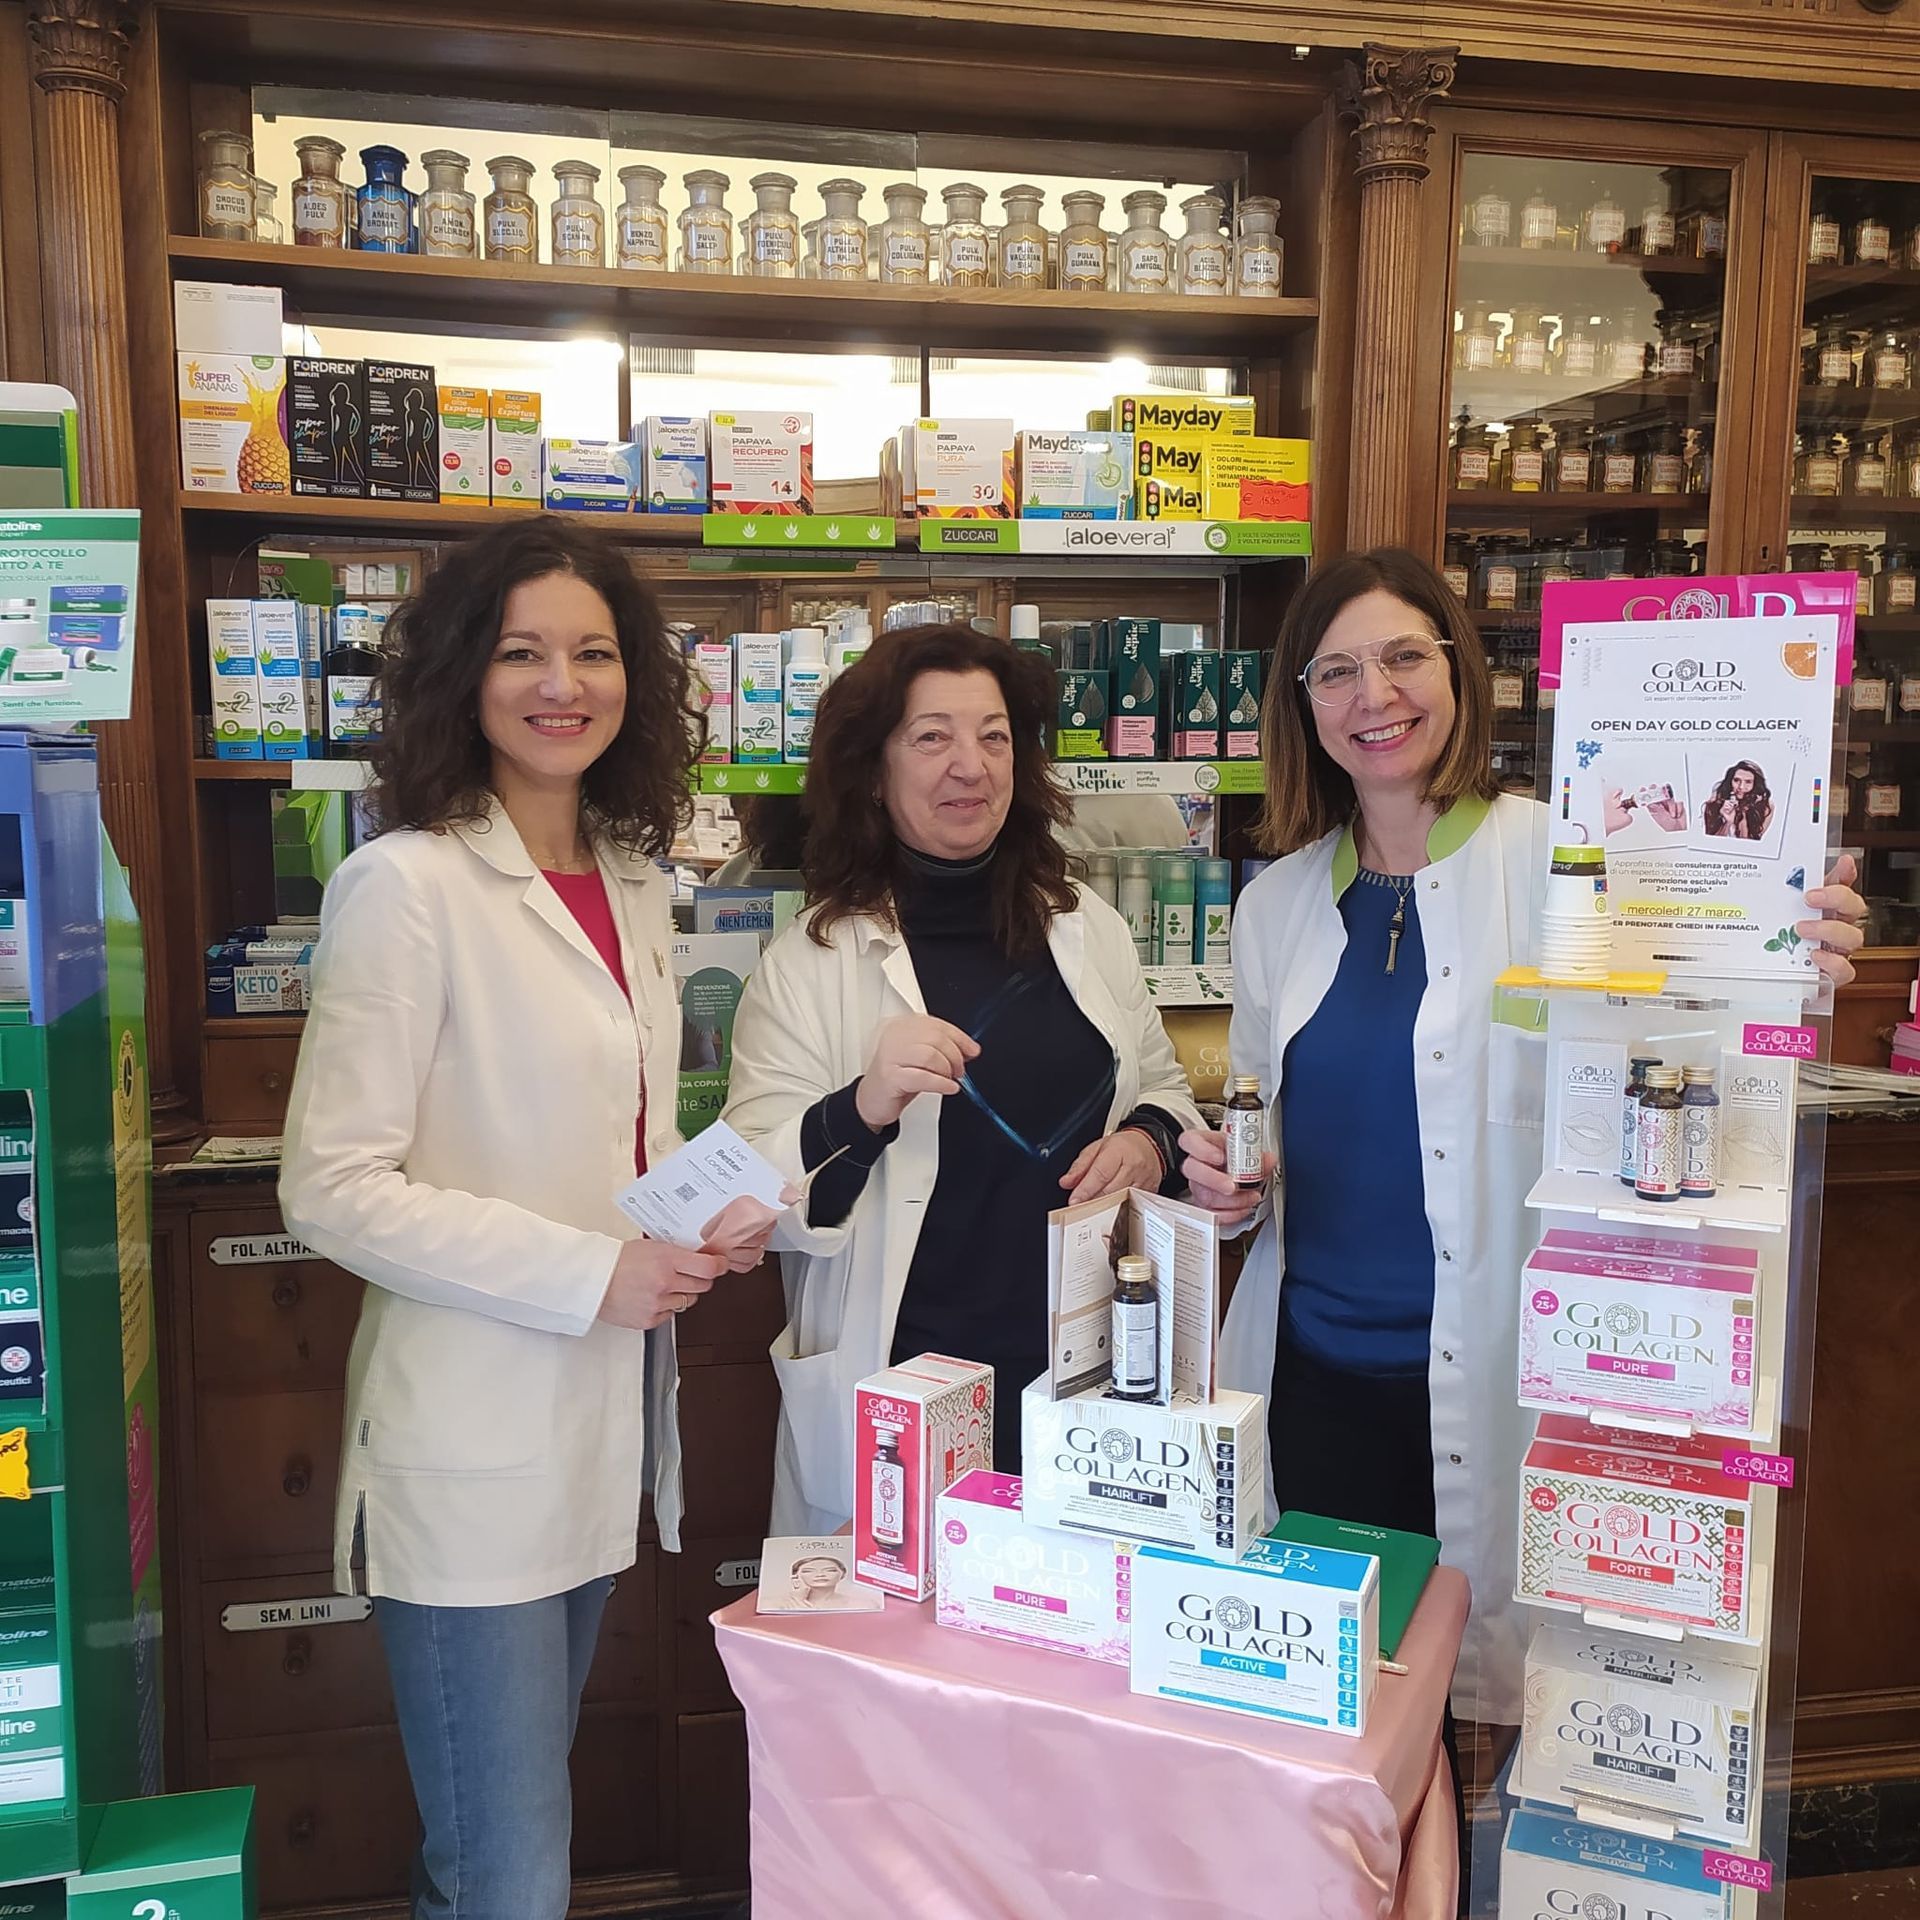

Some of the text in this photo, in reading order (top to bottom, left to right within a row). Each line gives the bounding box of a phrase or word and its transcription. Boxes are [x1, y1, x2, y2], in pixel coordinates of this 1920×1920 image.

[216, 204, 245, 214] SATIVUS
[304, 202, 327, 211] ALOES
[1071, 259, 1101, 267] GUARANA
[293, 360, 355, 375] FORDREN
[369, 366, 429, 380] FORDREN
[194, 372, 231, 382] SUPER
[194, 383, 238, 392] ANANAS
[296, 418, 325, 431] super
[1140, 403, 1223, 433] Mayday
[294, 426, 327, 444] shape
[371, 423, 399, 436] super
[369, 434, 401, 448] shape
[937, 444, 975, 452] PAPAYA
[771, 481, 792, 494] 14
[972, 485, 995, 499] 30
[1063, 511, 1093, 519] ZUCCARI
[944, 529, 997, 542] ZUCCARI
[48, 561, 63, 570] TE
[1652, 658, 1736, 680] GOLD
[1591, 720, 1711, 731] OPEN DAY GOLD
[1077, 765, 1107, 779] Pur
[1067, 777, 1127, 792] Aseptic
[1628, 905, 1742, 918] mercoledì 27 marzo
[1625, 921, 1673, 929] PRENOTARE
[237, 976, 278, 994] KETO
[1756, 1030, 1811, 1044] GOLD
[1572, 1066, 1612, 1076] GOLD
[1568, 1075, 1616, 1083] COLLAGEN
[1734, 1077, 1778, 1088] GOLD
[1730, 1085, 1783, 1095] COLLAGEN
[1242, 1113, 1259, 1167] GOLD
[1640, 1111, 1664, 1176] GOLD
[1682, 1108, 1708, 1172] GOLD
[714, 1149, 743, 1173] Better
[729, 1145, 748, 1162] Live
[704, 1154, 734, 1182] Longer
[231, 1241, 316, 1257] FOL. ALTHA
[1536, 1300, 1554, 1310] 25+
[1566, 1302, 1702, 1340] GOLD
[1613, 1360, 1649, 1374] PURE
[869, 1398, 908, 1415] GOLD
[1066, 1427, 1189, 1467] GOLD
[1734, 1457, 1788, 1474] GOLD
[880, 1468, 897, 1524] GOLD
[1101, 1486, 1156, 1505] HAIRLIFT
[1534, 1497, 1555, 1507] 40+
[1566, 1504, 1702, 1544] GOLD
[947, 1530, 964, 1539] 25+
[973, 1534, 1090, 1575] GOLD
[1610, 1561, 1652, 1577] FORTE
[1015, 1593, 1046, 1608] PURE
[260, 1604, 330, 1623] SEM. LINI
[1178, 1594, 1312, 1638] GOLD
[1220, 1656, 1267, 1673] ACTIVE
[1590, 1644, 1694, 1672] GOLD
[1613, 1667, 1663, 1682] HAIRLIFT
[1570, 1700, 1701, 1746] GOLD
[1606, 1757, 1662, 1778] HAIRLIFT
[1563, 1827, 1665, 1856] GOLD
[1592, 1855, 1630, 1867] ACTIVE
[1715, 1859, 1766, 1877] GOLD
